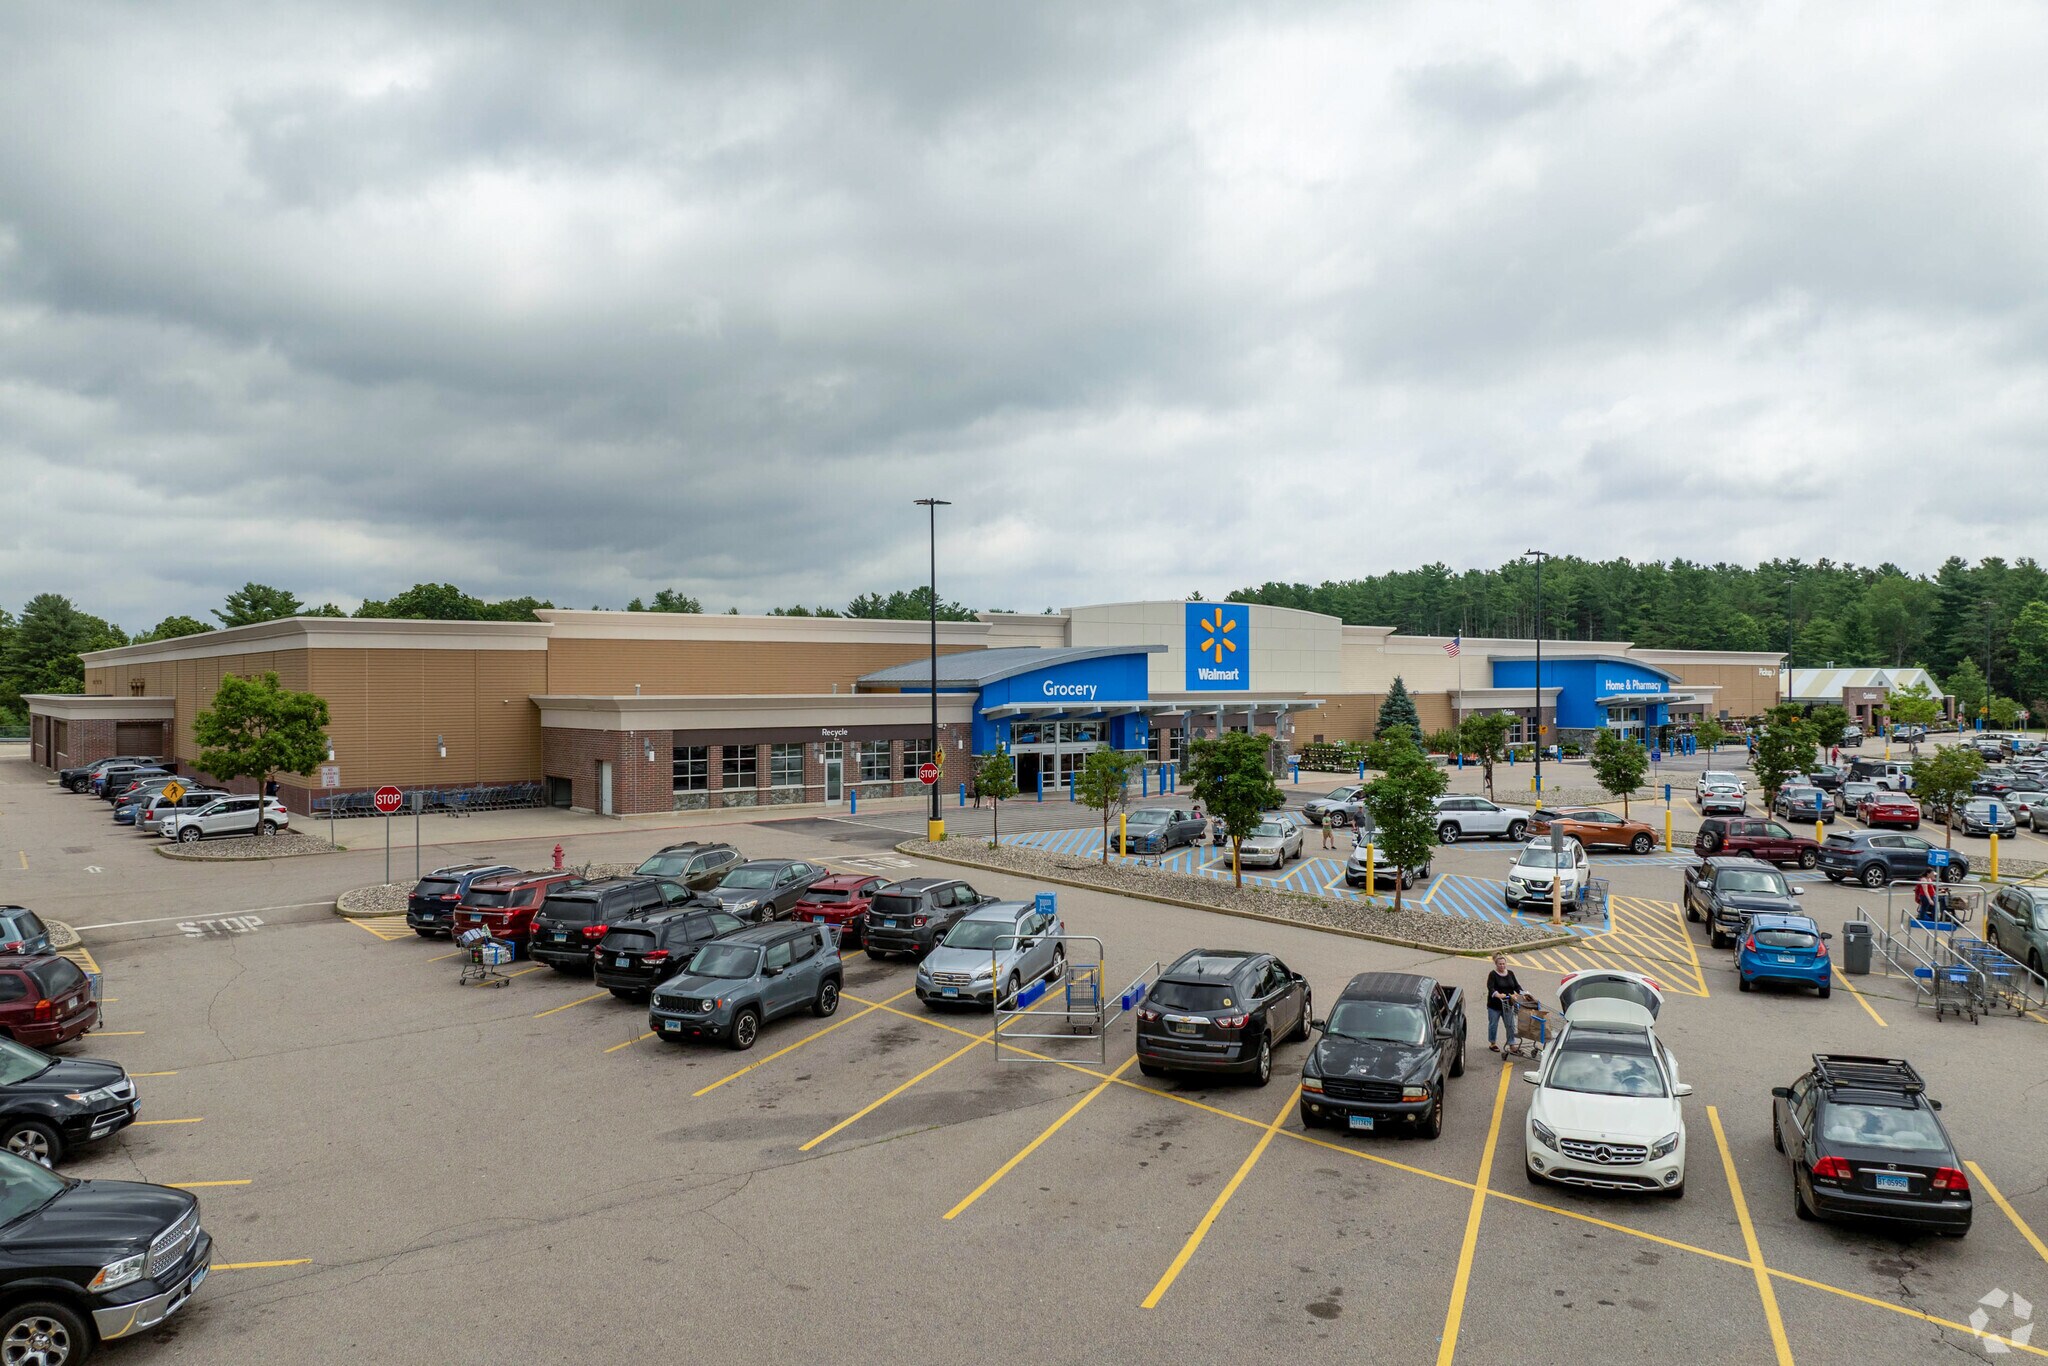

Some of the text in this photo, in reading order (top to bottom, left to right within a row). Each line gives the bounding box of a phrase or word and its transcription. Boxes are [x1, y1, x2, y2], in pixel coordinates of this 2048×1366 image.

[1198, 668, 1239, 680] Walmart
[1043, 680, 1097, 700] Grocery
[1606, 680, 1661, 692] Home & Pharmacy
[822, 728, 848, 737] Recycle
[920, 770, 937, 778] STOP
[376, 794, 400, 804] STOP
[176, 916, 264, 938] STOP
